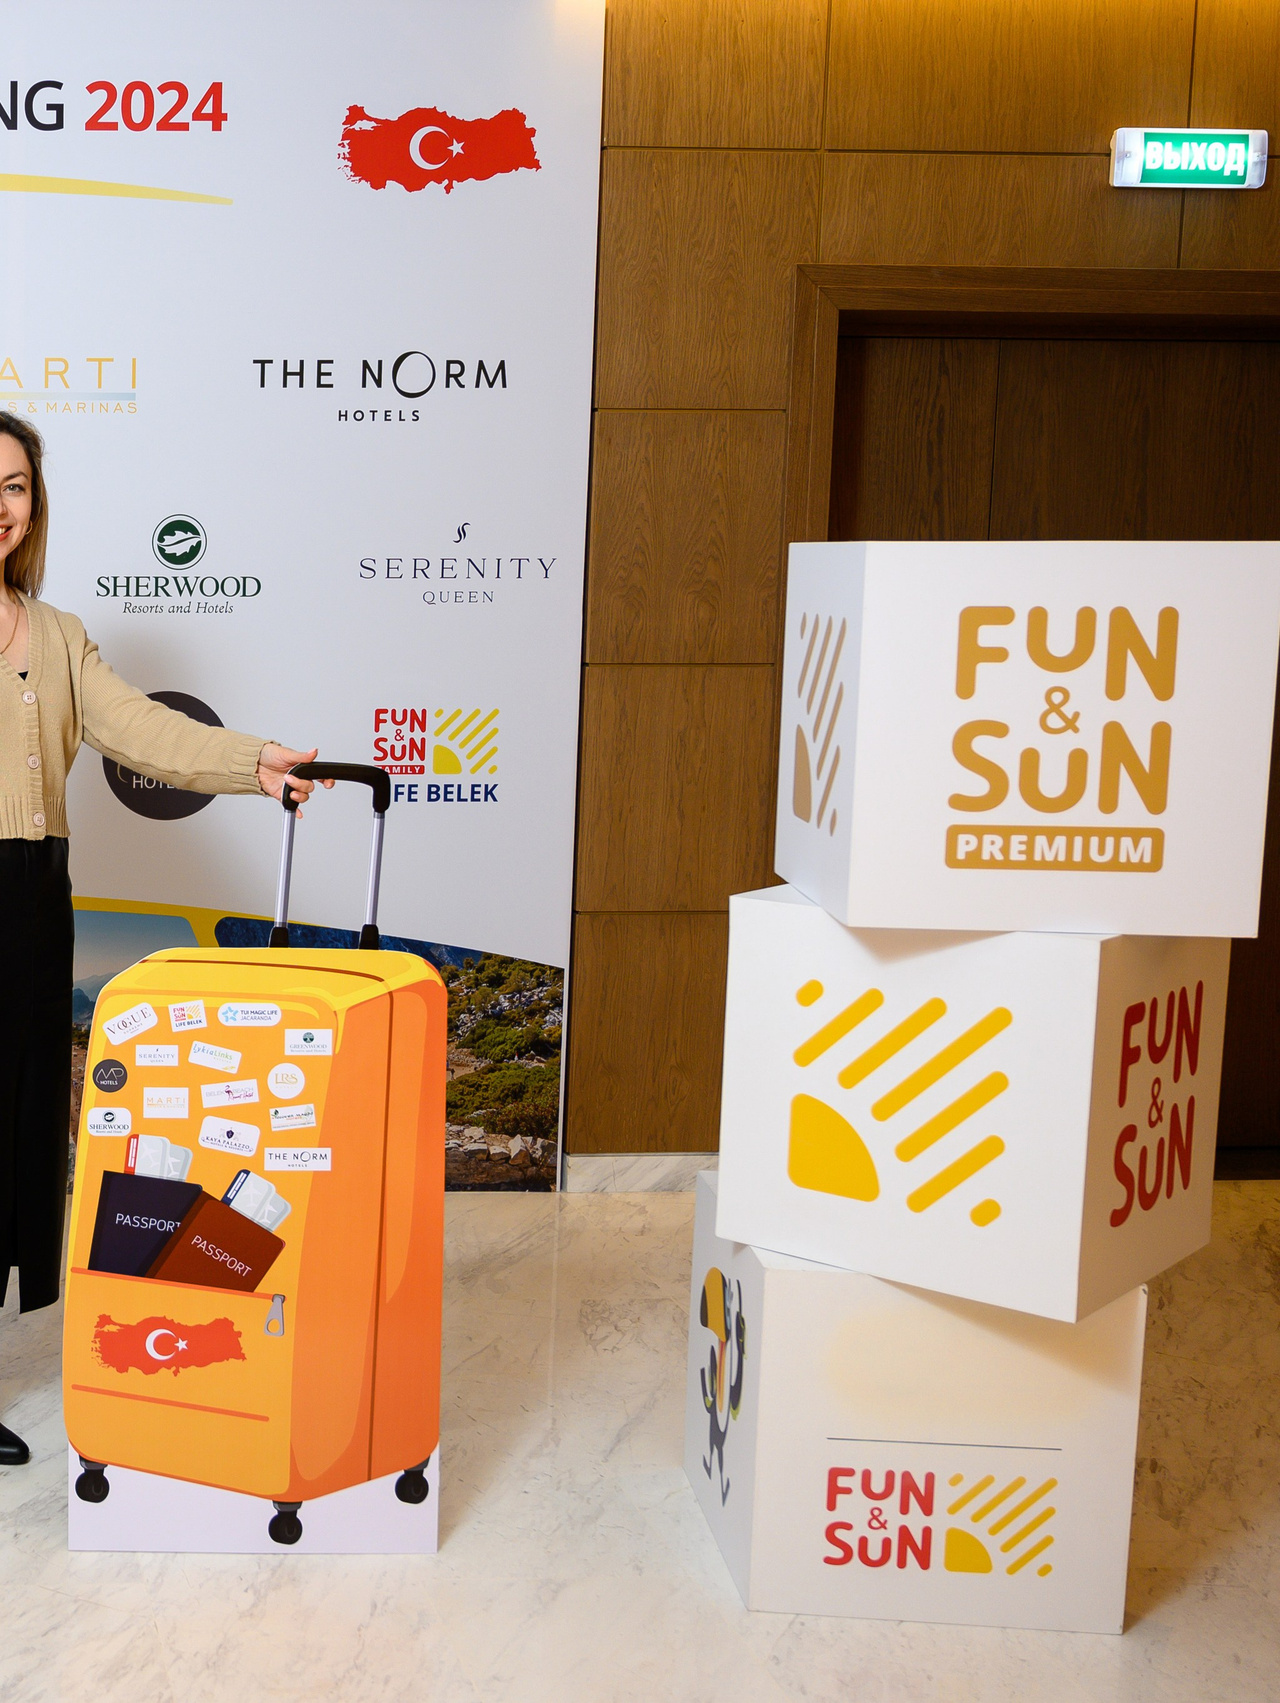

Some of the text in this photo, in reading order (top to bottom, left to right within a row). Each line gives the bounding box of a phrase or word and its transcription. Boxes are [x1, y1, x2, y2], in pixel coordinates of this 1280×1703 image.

[84, 81, 228, 132] 2024
[1146, 142, 1245, 176] ВЫХОД
[253, 350, 507, 398] THE NORM
[27, 402, 37, 413] &
[46, 402, 138, 414] MARINAS
[338, 410, 420, 422] HOTELS
[359, 558, 557, 580] SERENITY
[96, 576, 261, 598] SHERWOOD
[422, 590, 494, 605] QUEEN
[122, 602, 234, 614] Resorts and Hotels
[956, 606, 1179, 701] FUN
[375, 709, 426, 732] FUN
[1040, 686, 1080, 734] &
[394, 729, 404, 742] &
[374, 737, 426, 762] SUN
[948, 720, 1172, 815] SUN
[394, 784, 498, 802] FE BELEK
[956, 834, 1152, 864] PREMIUM
[107, 1007, 151, 1034] VOGUE
[1118, 980, 1203, 1108] FUN
[275, 1073, 298, 1084] LRS
[1148, 1076, 1163, 1128] &
[206, 1136, 221, 1144] KAYA
[222, 1140, 250, 1150] PALAZZO
[293, 1151, 328, 1162] NORM
[1110, 1095, 1194, 1227] SUN
[191, 1235, 252, 1276] PASSPORT
[826, 1467, 935, 1516] FUN
[868, 1507, 888, 1530] &
[823, 1521, 932, 1570] SUN
